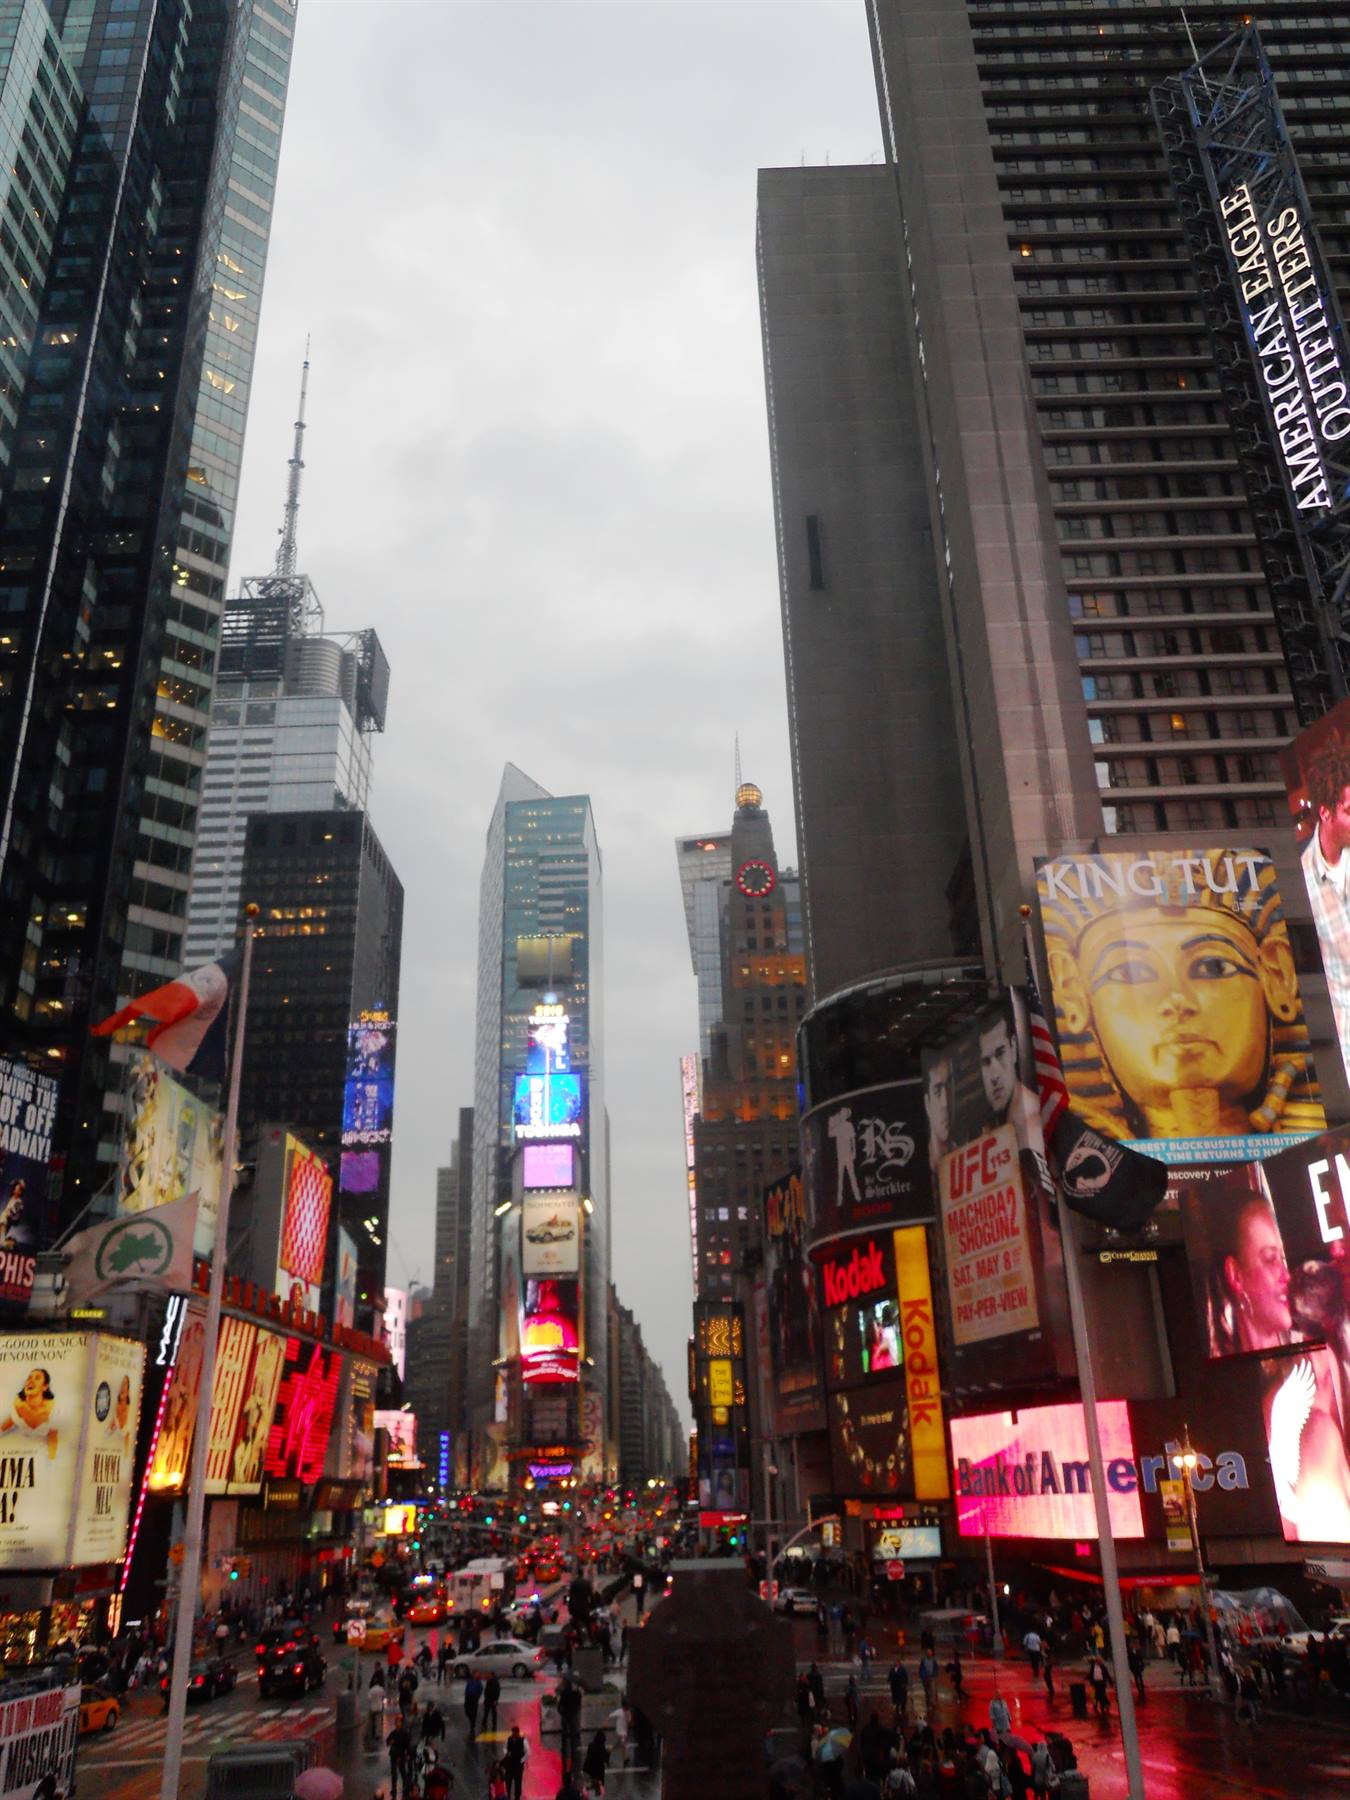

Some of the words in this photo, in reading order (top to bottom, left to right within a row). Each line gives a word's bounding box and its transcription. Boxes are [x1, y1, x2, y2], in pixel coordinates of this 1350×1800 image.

[1220, 183, 1273, 304] EAGLE
[1267, 207, 1350, 441] OUTFITTERS
[1242, 302, 1331, 512] AMERICAN
[1043, 860, 1162, 901] KING
[1172, 856, 1265, 895] TUT
[25, 1103, 55, 1137] OFF
[36, 1087, 58, 1112] THE
[0, 1124, 51, 1164] ADWAY!
[515, 1122, 582, 1138] TOSHIBA
[950, 1136, 998, 1200] UFC
[991, 1147, 1012, 1168] 113
[1166, 1150, 1193, 1162] TIME
[1195, 1148, 1245, 1160] RETURNS
[1247, 1148, 1260, 1158] TO
[948, 1190, 1008, 1237] MACHIDA
[959, 1216, 1008, 1256] SHOGUN
[1006, 1185, 1020, 1236] 2
[823, 1238, 887, 1308] Kodak
[975, 1255, 1000, 1280] MAY
[1003, 1250, 1012, 1272] 8
[956, 1285, 1028, 1324] PAY-PER-VIEW
[40, 1336, 89, 1348] MUSICAL
[902, 1297, 938, 1427] Kodak
[958, 1456, 1011, 1496] Bank
[1013, 1452, 1038, 1496] of
[1040, 1440, 1250, 1495] America
